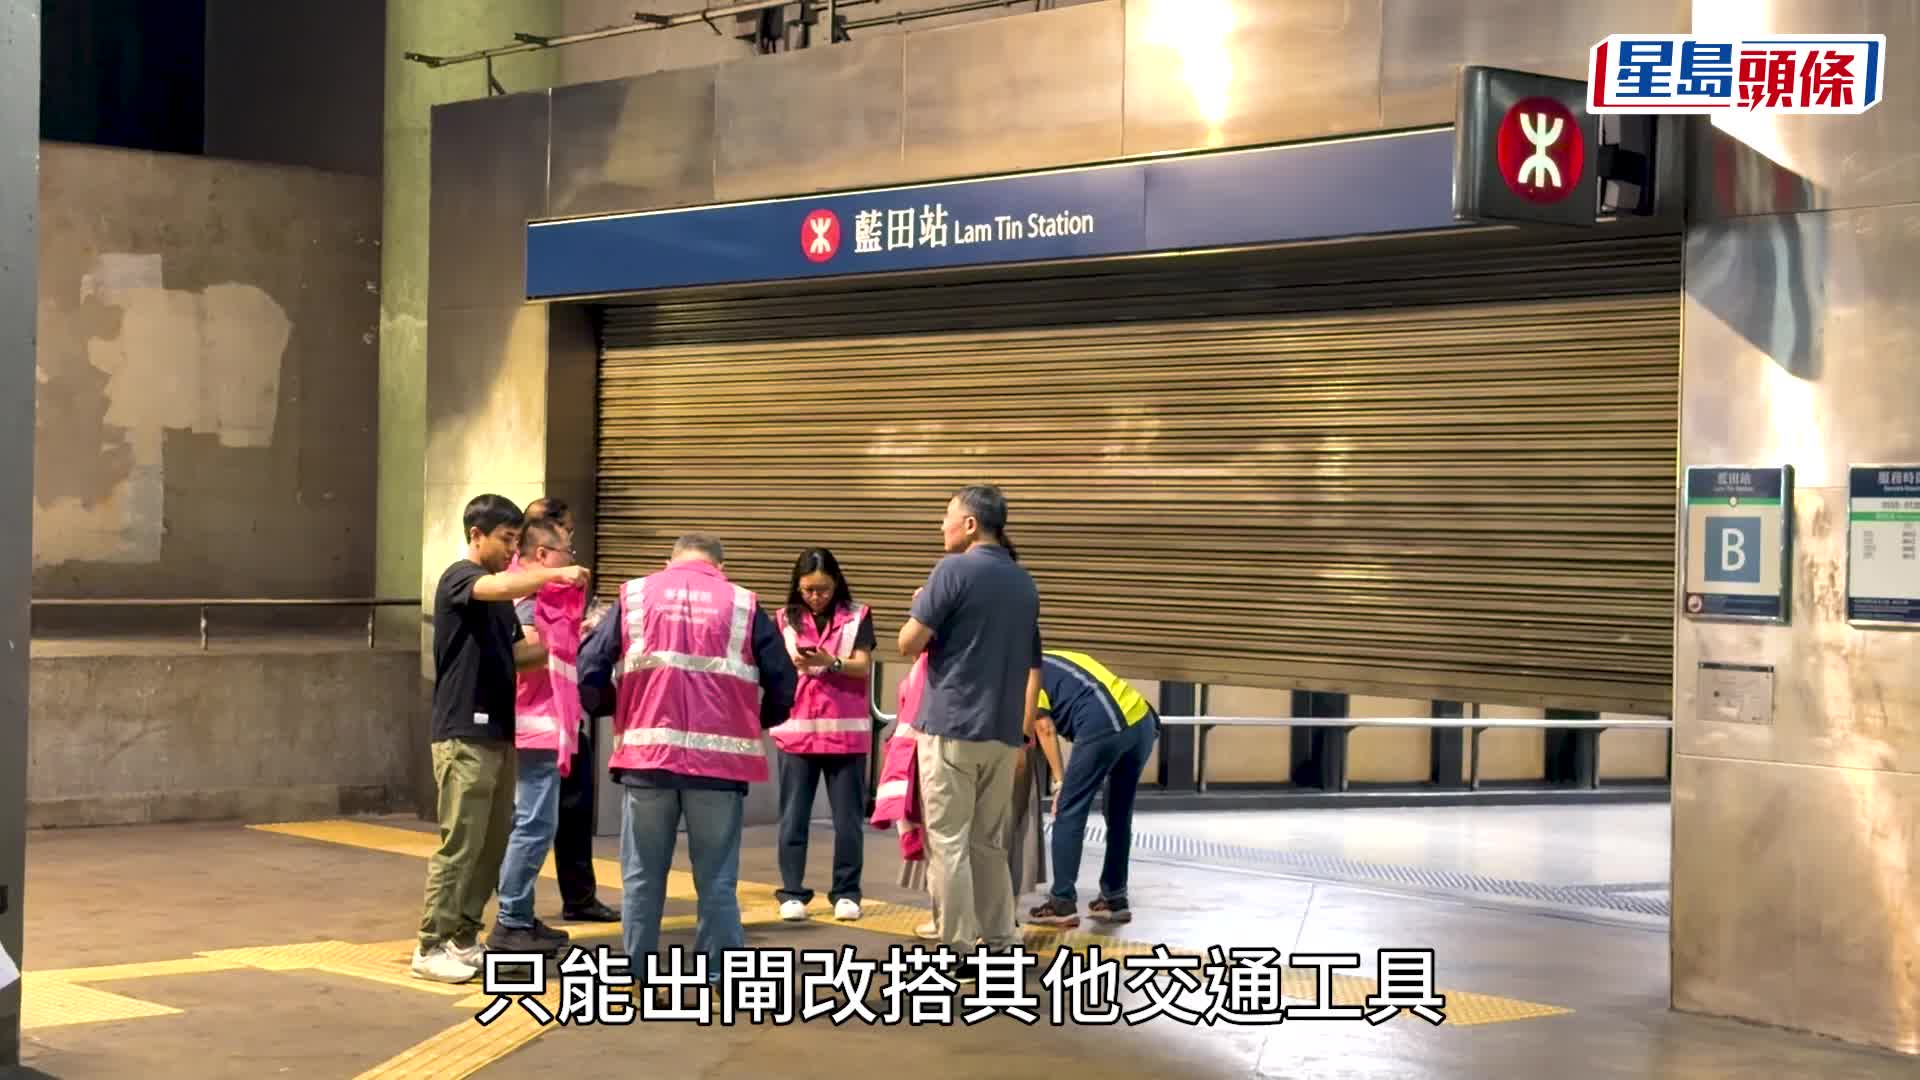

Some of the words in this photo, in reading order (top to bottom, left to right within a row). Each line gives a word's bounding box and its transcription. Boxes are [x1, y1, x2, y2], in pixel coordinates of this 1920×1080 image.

[854, 203, 949, 253] 藍田站
[954, 219, 992, 244] Lam
[994, 215, 1023, 241] Tin
[1027, 210, 1094, 239] Station
[1721, 528, 1746, 571] B
